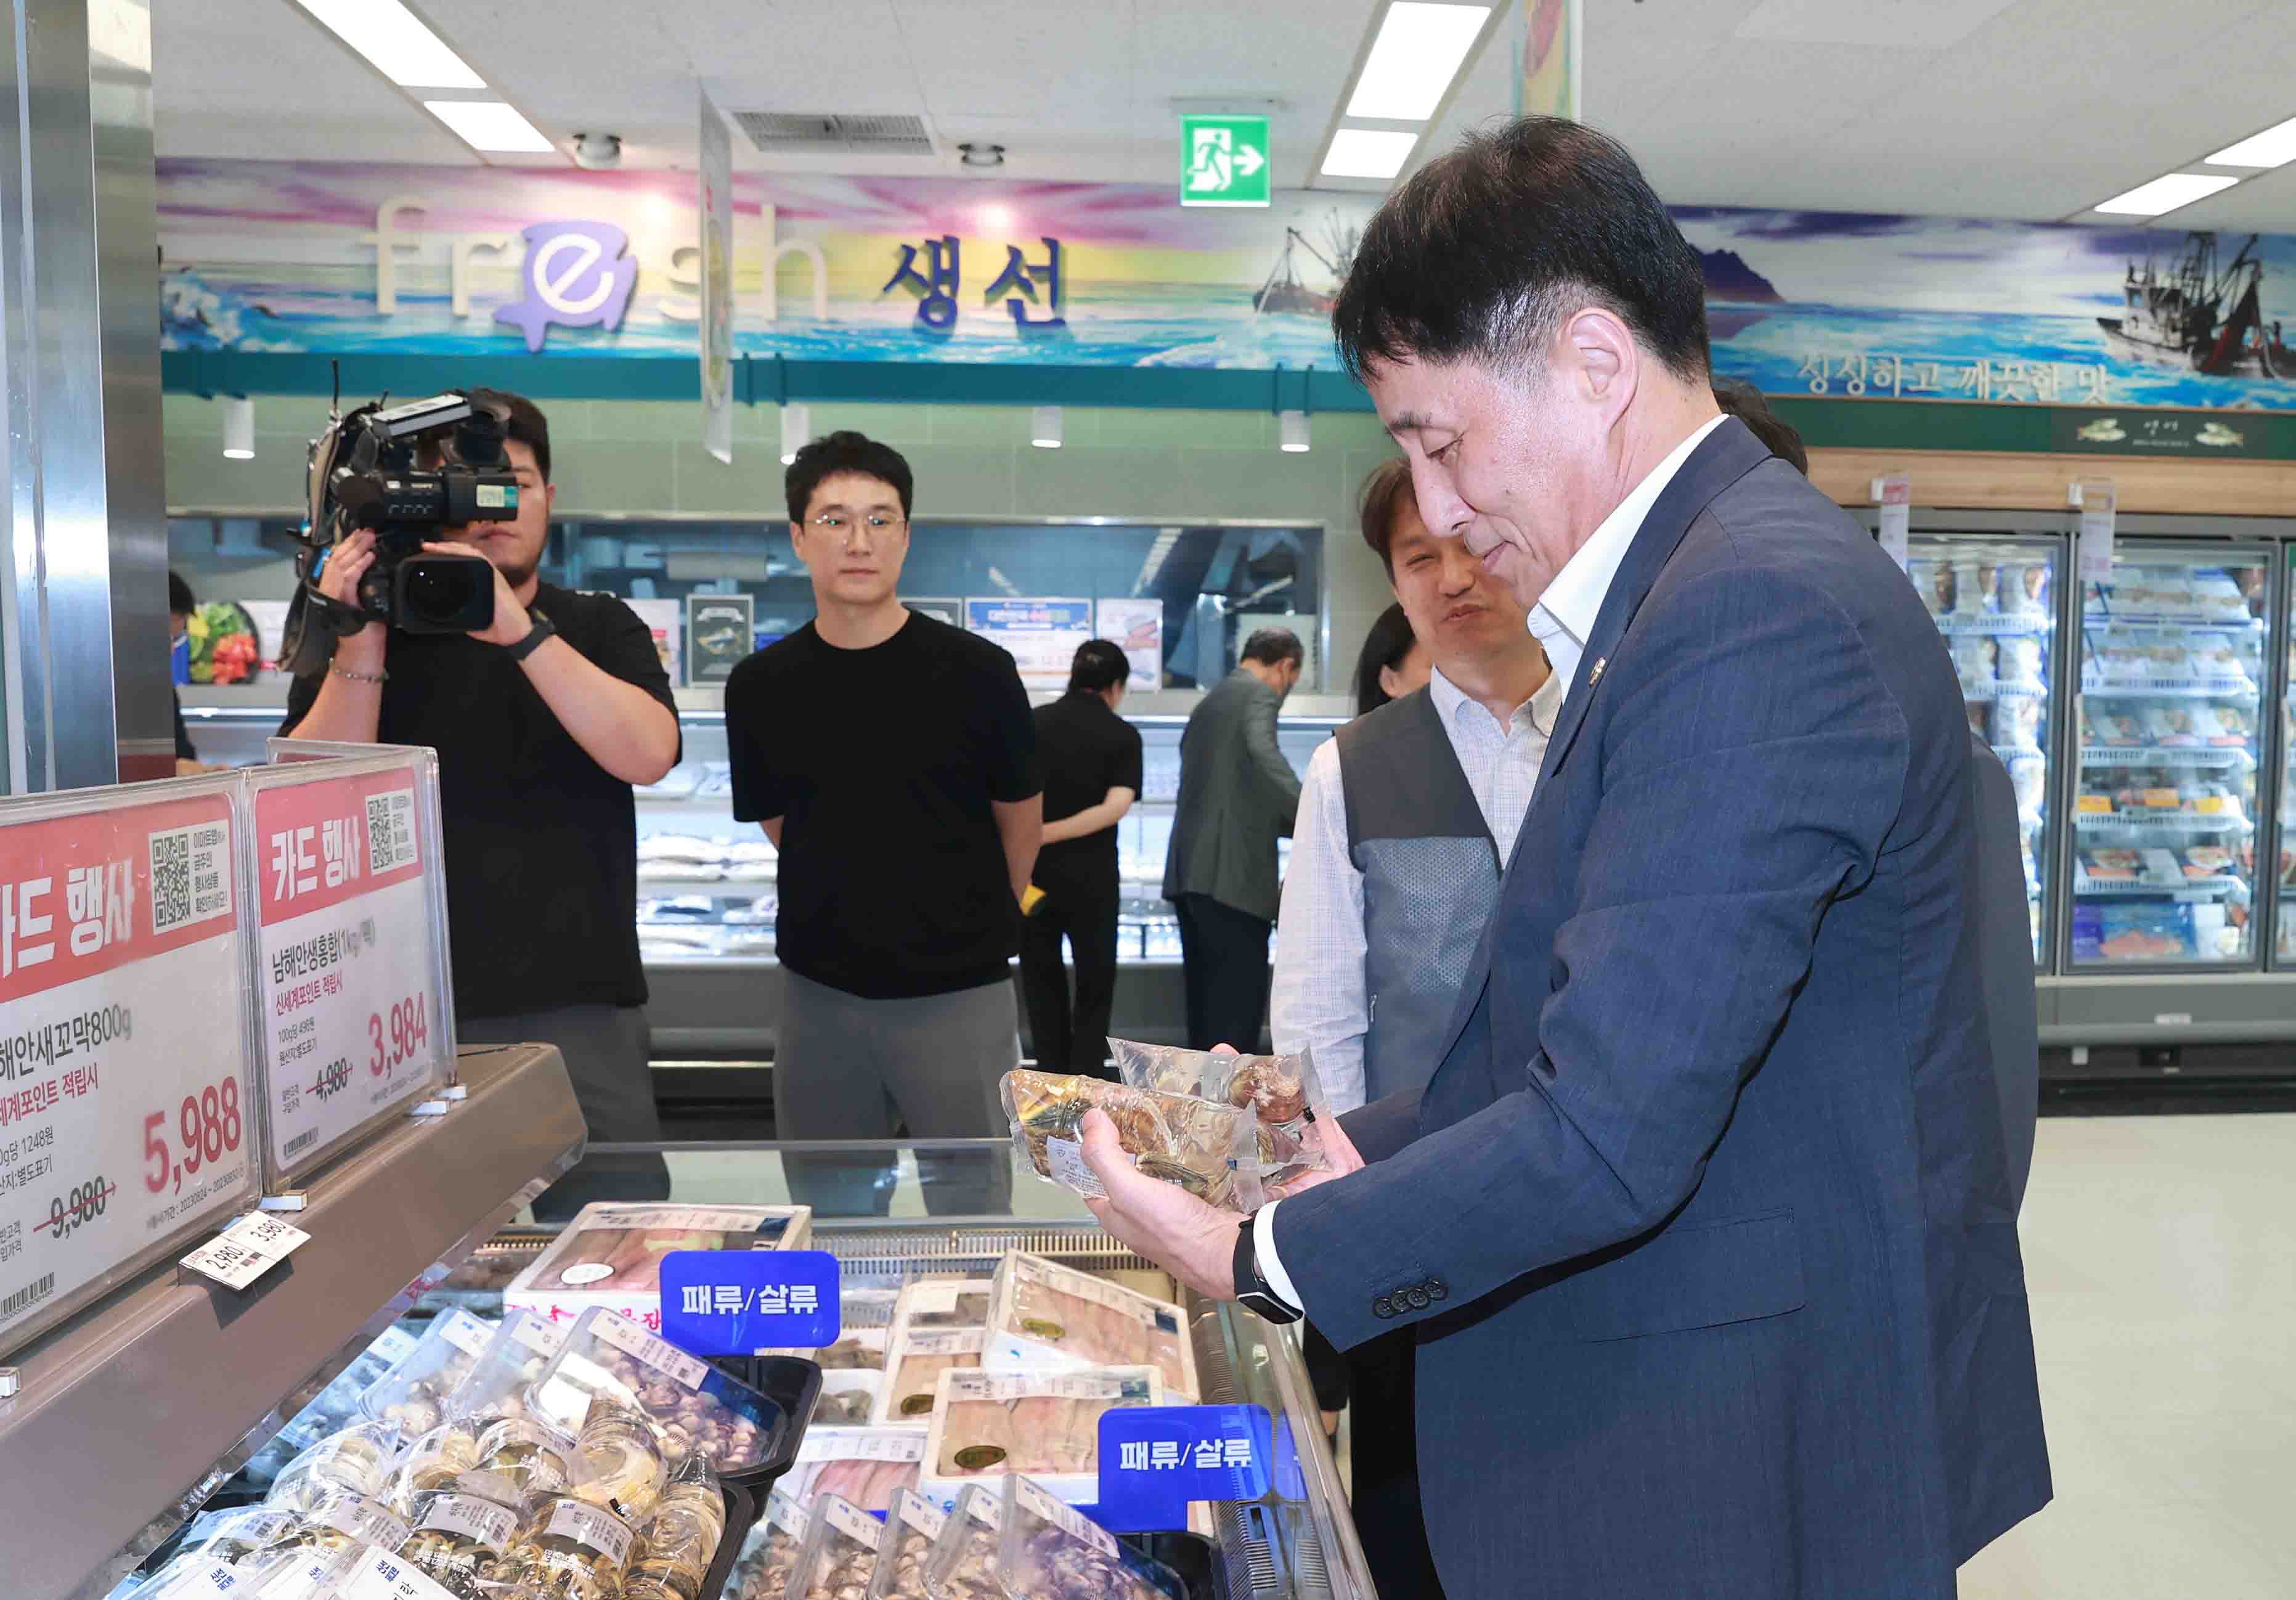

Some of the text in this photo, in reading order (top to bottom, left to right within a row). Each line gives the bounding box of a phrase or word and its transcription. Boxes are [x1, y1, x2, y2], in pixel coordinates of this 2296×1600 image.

[362, 194, 828, 322] fresh
[882, 234, 1067, 329] 생선
[1798, 353, 2112, 405] 싱싱하고 깨끗한 맛
[271, 825, 318, 902] 카드
[322, 815, 361, 888] 행사
[66, 857, 135, 957] 행사
[369, 991, 427, 1079] 3,984
[62, 1062, 99, 1098] 적립시
[315, 1057, 348, 1103] 4,980
[21, 1124, 54, 1154] 1248원
[144, 1076, 242, 1196] 5,988
[49, 1175, 107, 1239] 9,980
[251, 1219, 287, 1242] 3,980
[205, 1246, 244, 1270] 2,980
[680, 1284, 820, 1315] 패류/살류
[1119, 1439, 1253, 1471] 패류/살류
